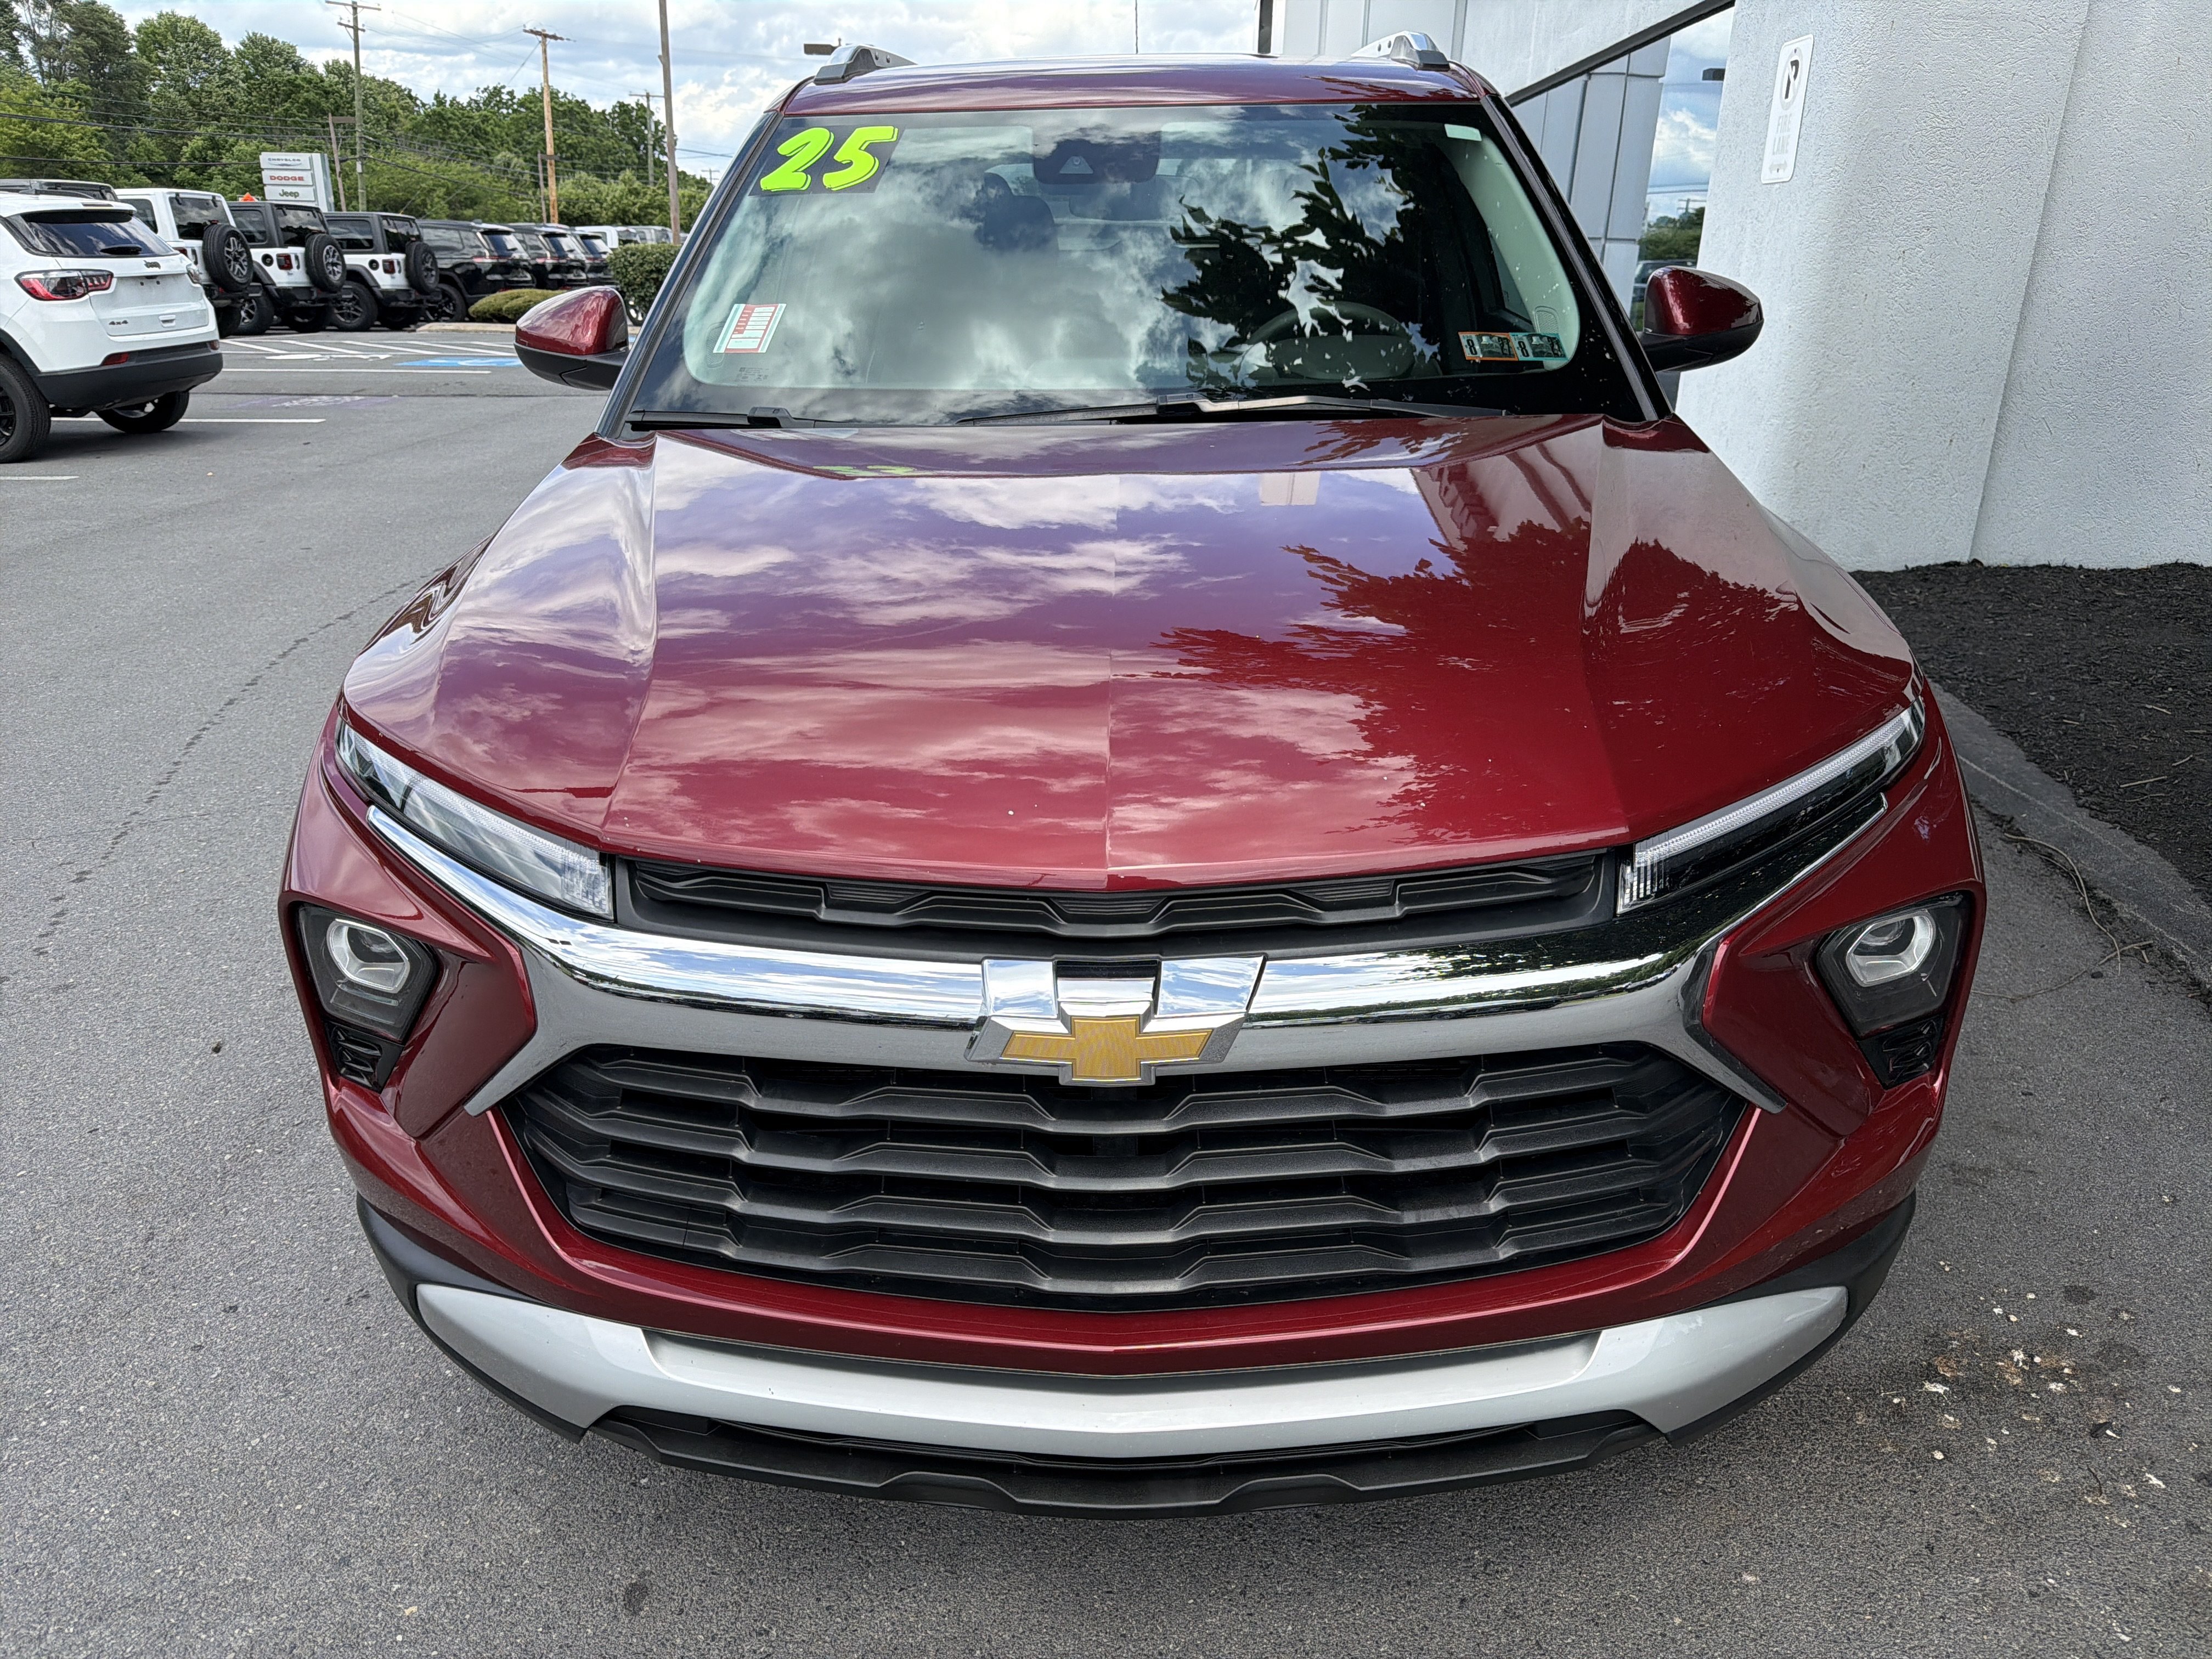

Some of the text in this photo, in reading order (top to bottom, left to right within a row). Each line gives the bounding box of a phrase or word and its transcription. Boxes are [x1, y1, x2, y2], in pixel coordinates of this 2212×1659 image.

[1776, 113, 1792, 133] FIRE
[1773, 134, 1790, 155] LANE
[760, 126, 899, 191] 25
[279, 189, 300, 199] Jeep
[1466, 338, 1478, 356] 8
[1517, 341, 1530, 357] 8
